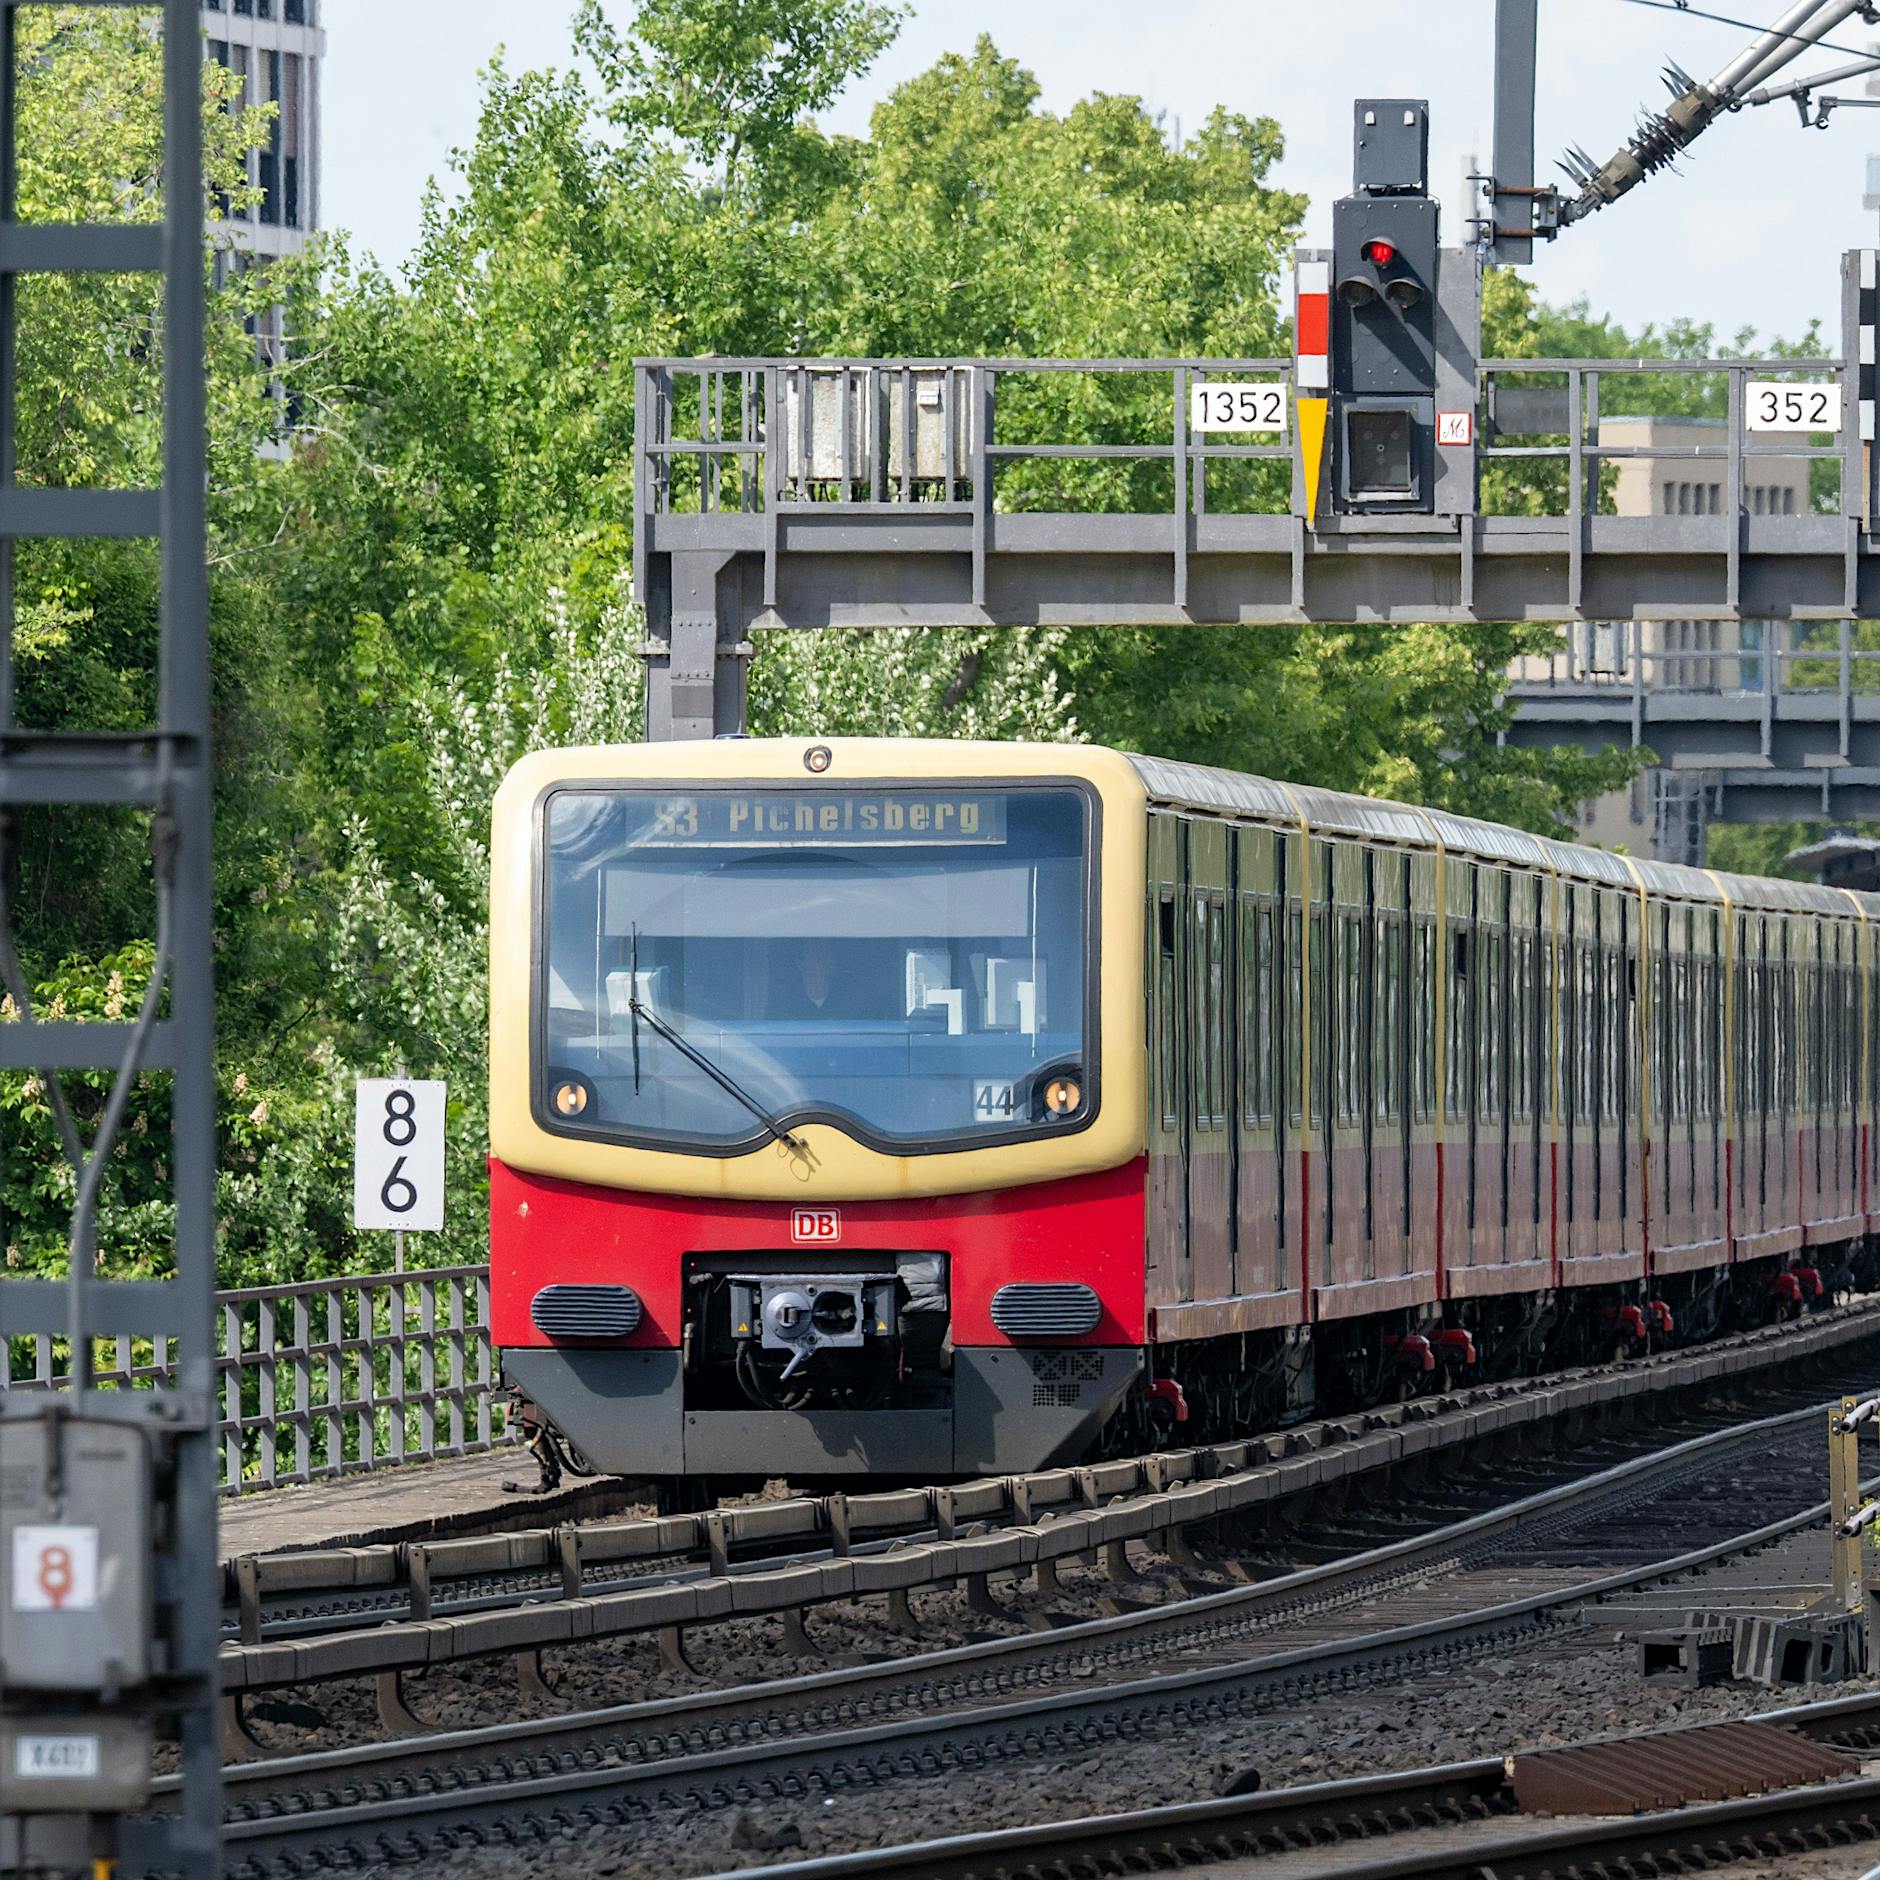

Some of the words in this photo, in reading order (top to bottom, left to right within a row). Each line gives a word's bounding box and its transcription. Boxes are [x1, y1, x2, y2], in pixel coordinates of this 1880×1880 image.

[1199, 391, 1281, 423] 1352
[1760, 391, 1828, 423] 352
[655, 798, 698, 836] S3
[729, 799, 979, 834] Pichelsberg
[976, 1085, 1014, 1116] 44
[383, 1089, 417, 1146] 8
[381, 1156, 417, 1213] 6
[798, 1213, 834, 1237] DB
